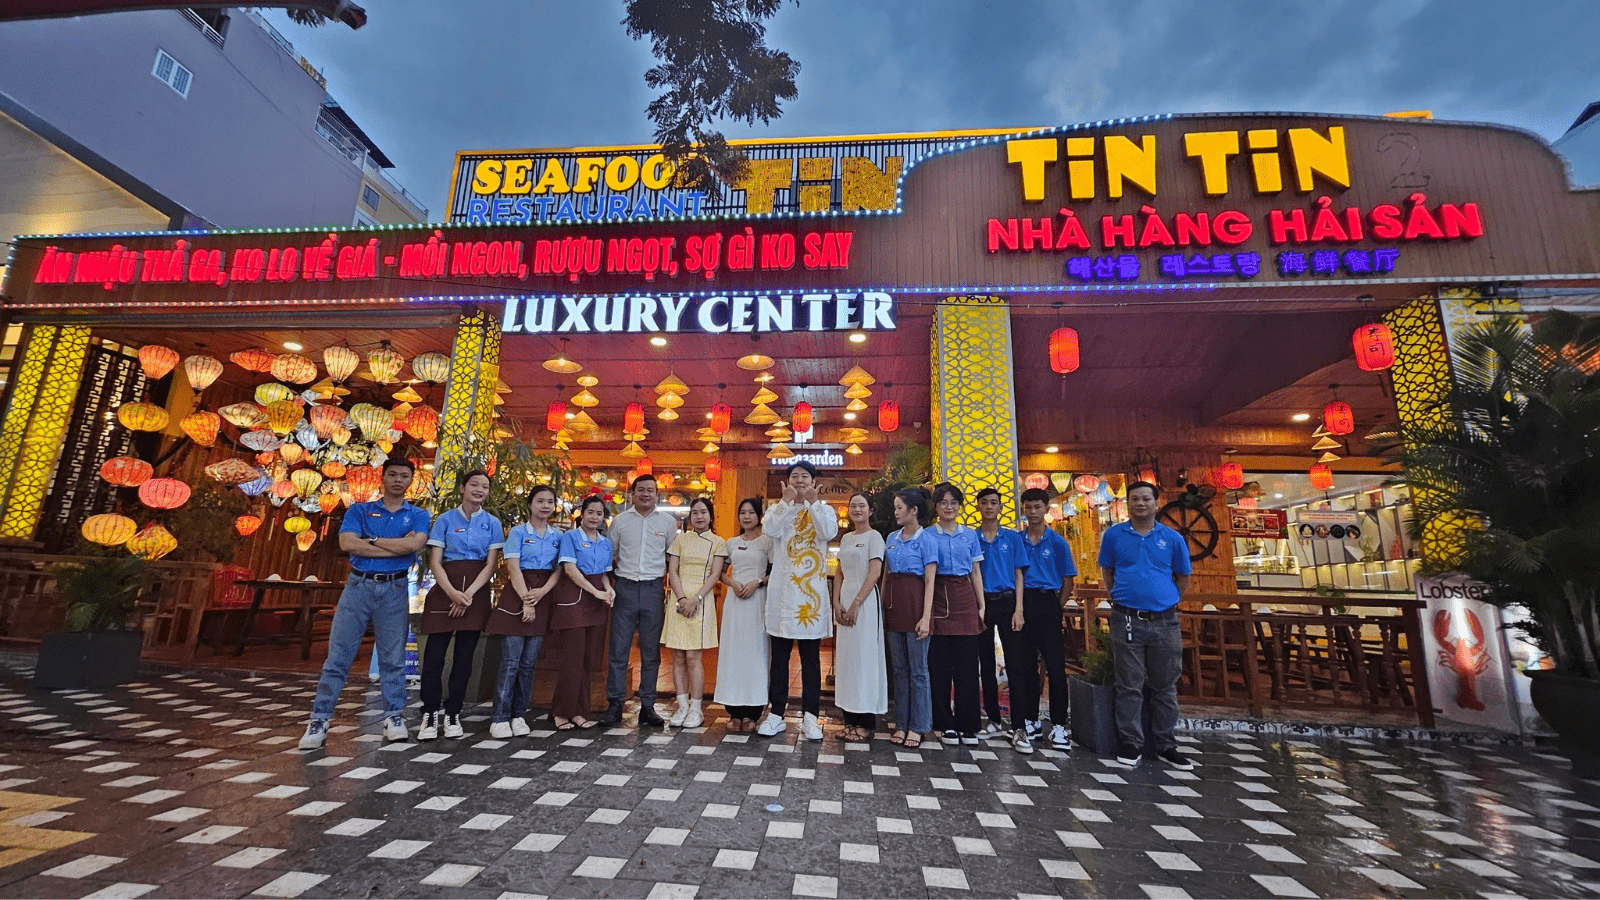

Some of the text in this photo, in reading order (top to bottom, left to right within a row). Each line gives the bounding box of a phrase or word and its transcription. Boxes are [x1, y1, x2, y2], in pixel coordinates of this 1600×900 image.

[467, 191, 707, 223] RESTAURANT
[987, 193, 1483, 252] NHÀ HÀNG HẢI SẢN
[141, 239, 185, 282] THẢ
[189, 248, 227, 286] GA,
[230, 248, 265, 281] KO
[266, 247, 299, 281] LO
[303, 233, 337, 279] VỀ
[336, 238, 378, 279] GIÁ
[384, 255, 395, 265] -
[399, 230, 448, 277] MỒI
[451, 241, 527, 279] NGON,
[533, 236, 602, 282] RƯỢU
[607, 237, 678, 280] NGỌT,
[686, 232, 723, 279] SỢ
[728, 227, 754, 270] GÌ
[761, 233, 796, 269] KO
[804, 232, 854, 269] SAY
[1067, 252, 1261, 280] 해산물 레스토랑
[501, 291, 896, 334] LUXURY CENTER
